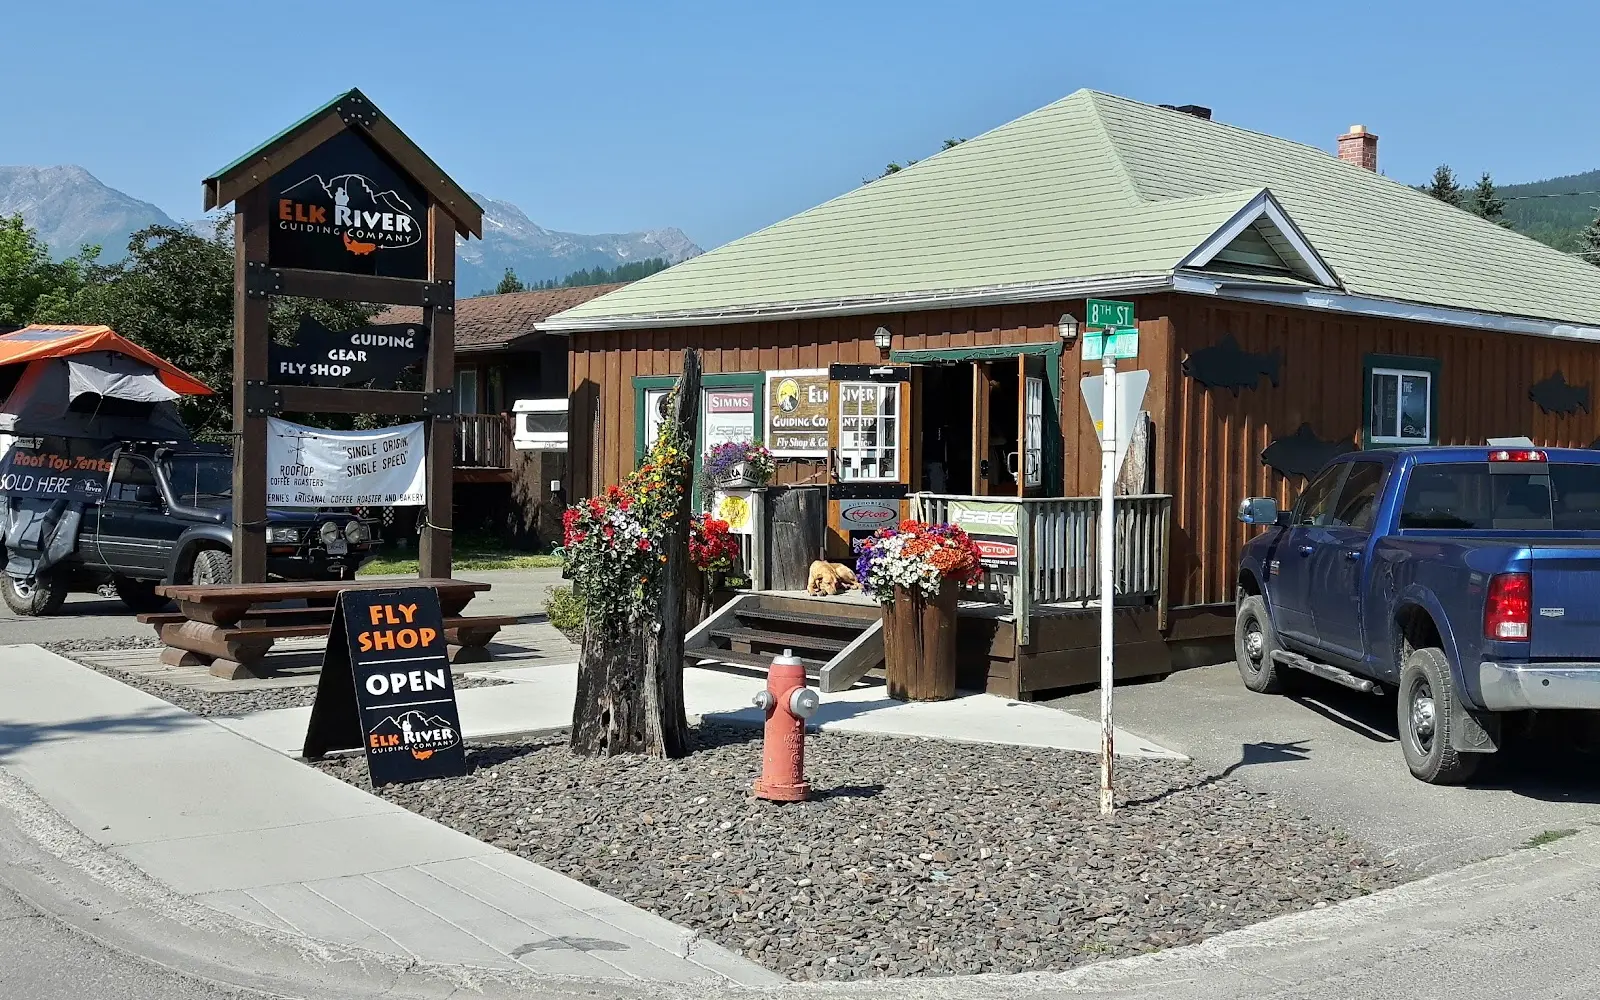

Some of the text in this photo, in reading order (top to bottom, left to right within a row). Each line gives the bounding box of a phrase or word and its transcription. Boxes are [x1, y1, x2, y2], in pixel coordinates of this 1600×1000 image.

[279, 199, 412, 233] ELK RIVER
[279, 220, 412, 243] GUIDING COMPANY
[1092, 303, 1130, 326] 8TH ST
[350, 333, 415, 349] GUIDING
[327, 349, 368, 362] GEAR
[280, 362, 352, 377] FLY SHOP
[712, 396, 749, 408] SIMMS
[772, 415, 810, 428] GUIDING
[776, 437, 789, 449] Fly
[789, 437, 809, 449] Shop
[810, 438, 816, 447] &
[13, 451, 113, 472] Roof Top Tents
[346, 460, 378, 478] SINGLE
[280, 465, 315, 478] ROOFTOP
[36, 476, 73, 494] HERE
[270, 477, 324, 487] COFFEE ROASTERS
[267, 493, 290, 503] ERNIE'S
[331, 495, 353, 504] COFFEE
[357, 494, 382, 504] ROASTER
[384, 493, 397, 502] AND
[399, 493, 424, 502] BAKERY
[369, 603, 418, 625] FLY
[358, 627, 436, 653] SHOP
[365, 668, 446, 696] OPEN
[369, 728, 453, 748] ELK RIVER
[371, 739, 454, 755] GUIDING COMPANY
